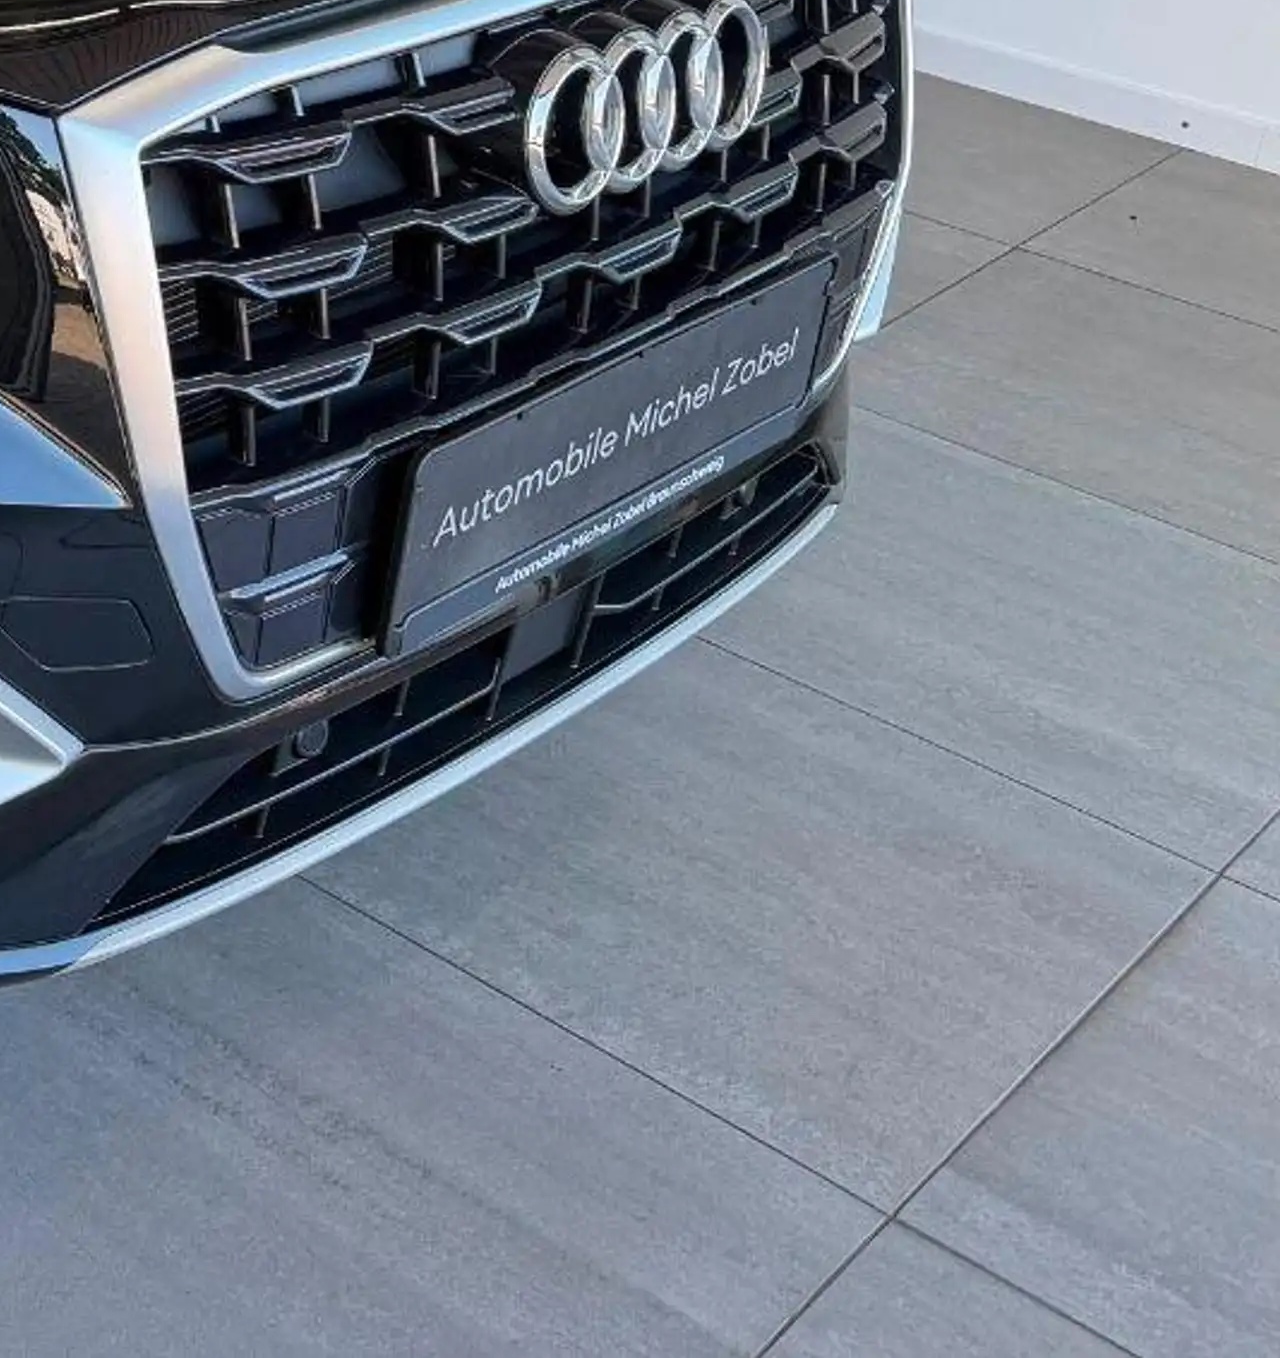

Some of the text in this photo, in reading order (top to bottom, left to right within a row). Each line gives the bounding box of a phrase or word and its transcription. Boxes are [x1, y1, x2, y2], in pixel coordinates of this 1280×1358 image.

[432, 327, 800, 548] Automobile Michel Zobel
[495, 540, 570, 594] Automobile
[570, 518, 612, 550] Michel
